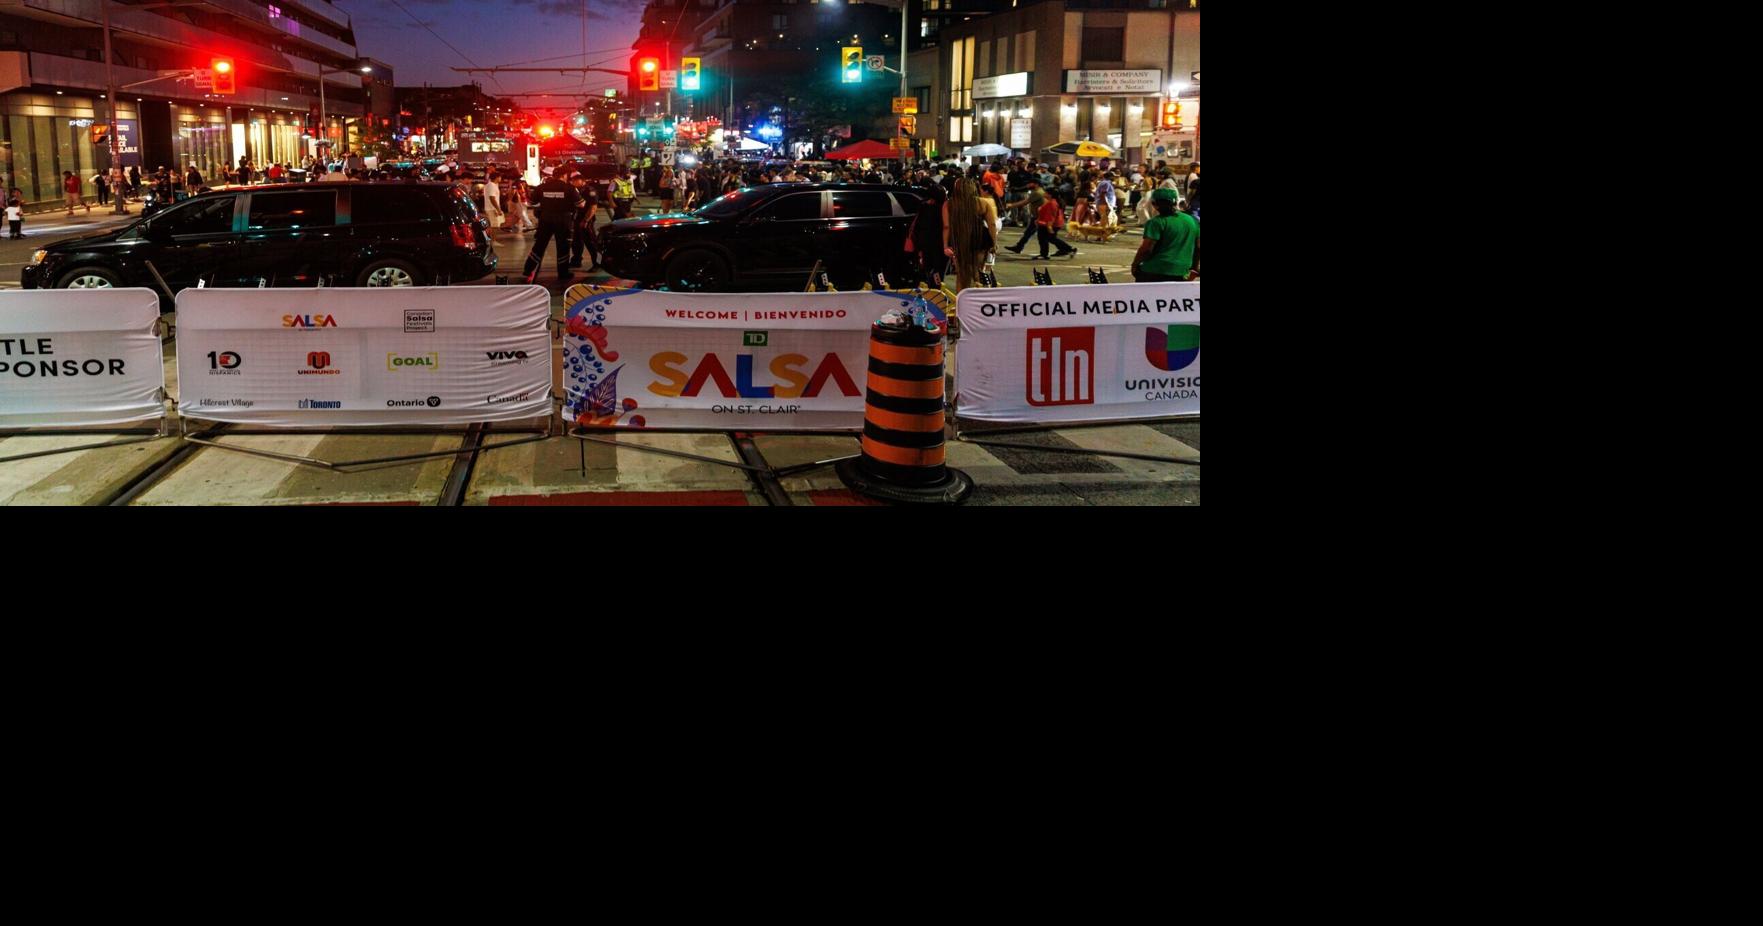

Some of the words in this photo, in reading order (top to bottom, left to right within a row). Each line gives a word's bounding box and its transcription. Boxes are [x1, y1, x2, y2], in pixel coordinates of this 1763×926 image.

[980, 300, 1076, 317] OFFICIAL
[1083, 299, 1150, 314] MEDIA
[666, 309, 738, 320] WELCOME
[754, 309, 847, 320] BIENVENIDO
[282, 314, 337, 328] SALSA
[746, 333, 766, 344] TD
[647, 351, 862, 398] SALSA
[488, 392, 529, 404] Canada
[1145, 390, 1198, 400] CANADA
[386, 399, 425, 407] Ontario
[712, 404, 734, 414] ON
[738, 404, 754, 414] ST.
